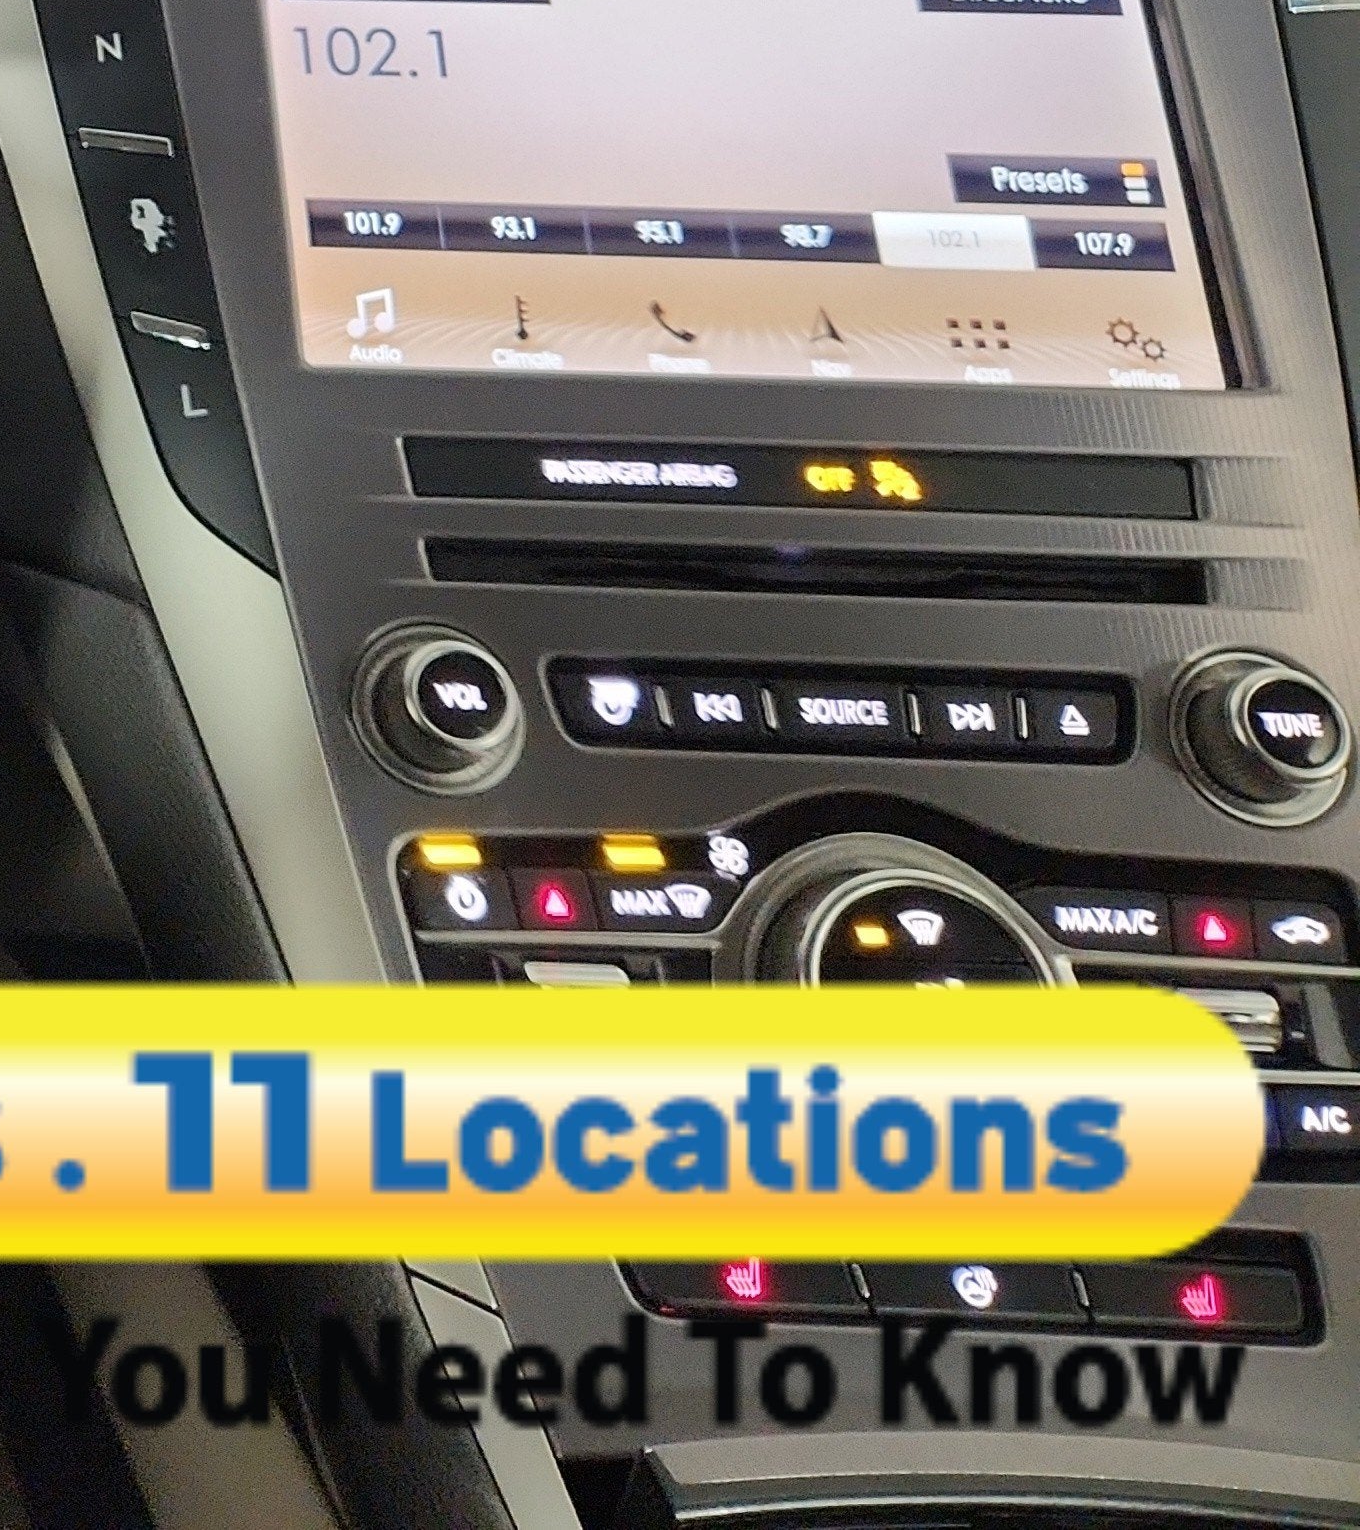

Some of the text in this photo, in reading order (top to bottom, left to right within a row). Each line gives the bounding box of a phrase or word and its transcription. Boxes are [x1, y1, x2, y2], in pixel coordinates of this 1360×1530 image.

[94, 32, 123, 63] N
[292, 25, 449, 79] 102.1
[990, 165, 1089, 196] Presets
[343, 210, 404, 237] 101.9
[489, 215, 538, 242] 93.1
[1074, 230, 1136, 258] 107.9
[348, 343, 404, 366] Audio
[180, 383, 210, 420] L
[432, 681, 489, 712] VOL
[797, 696, 890, 726] SOURCE
[1256, 711, 1325, 739] TUNE
[610, 888, 673, 917] MAX
[1054, 905, 1114, 934] MAX
